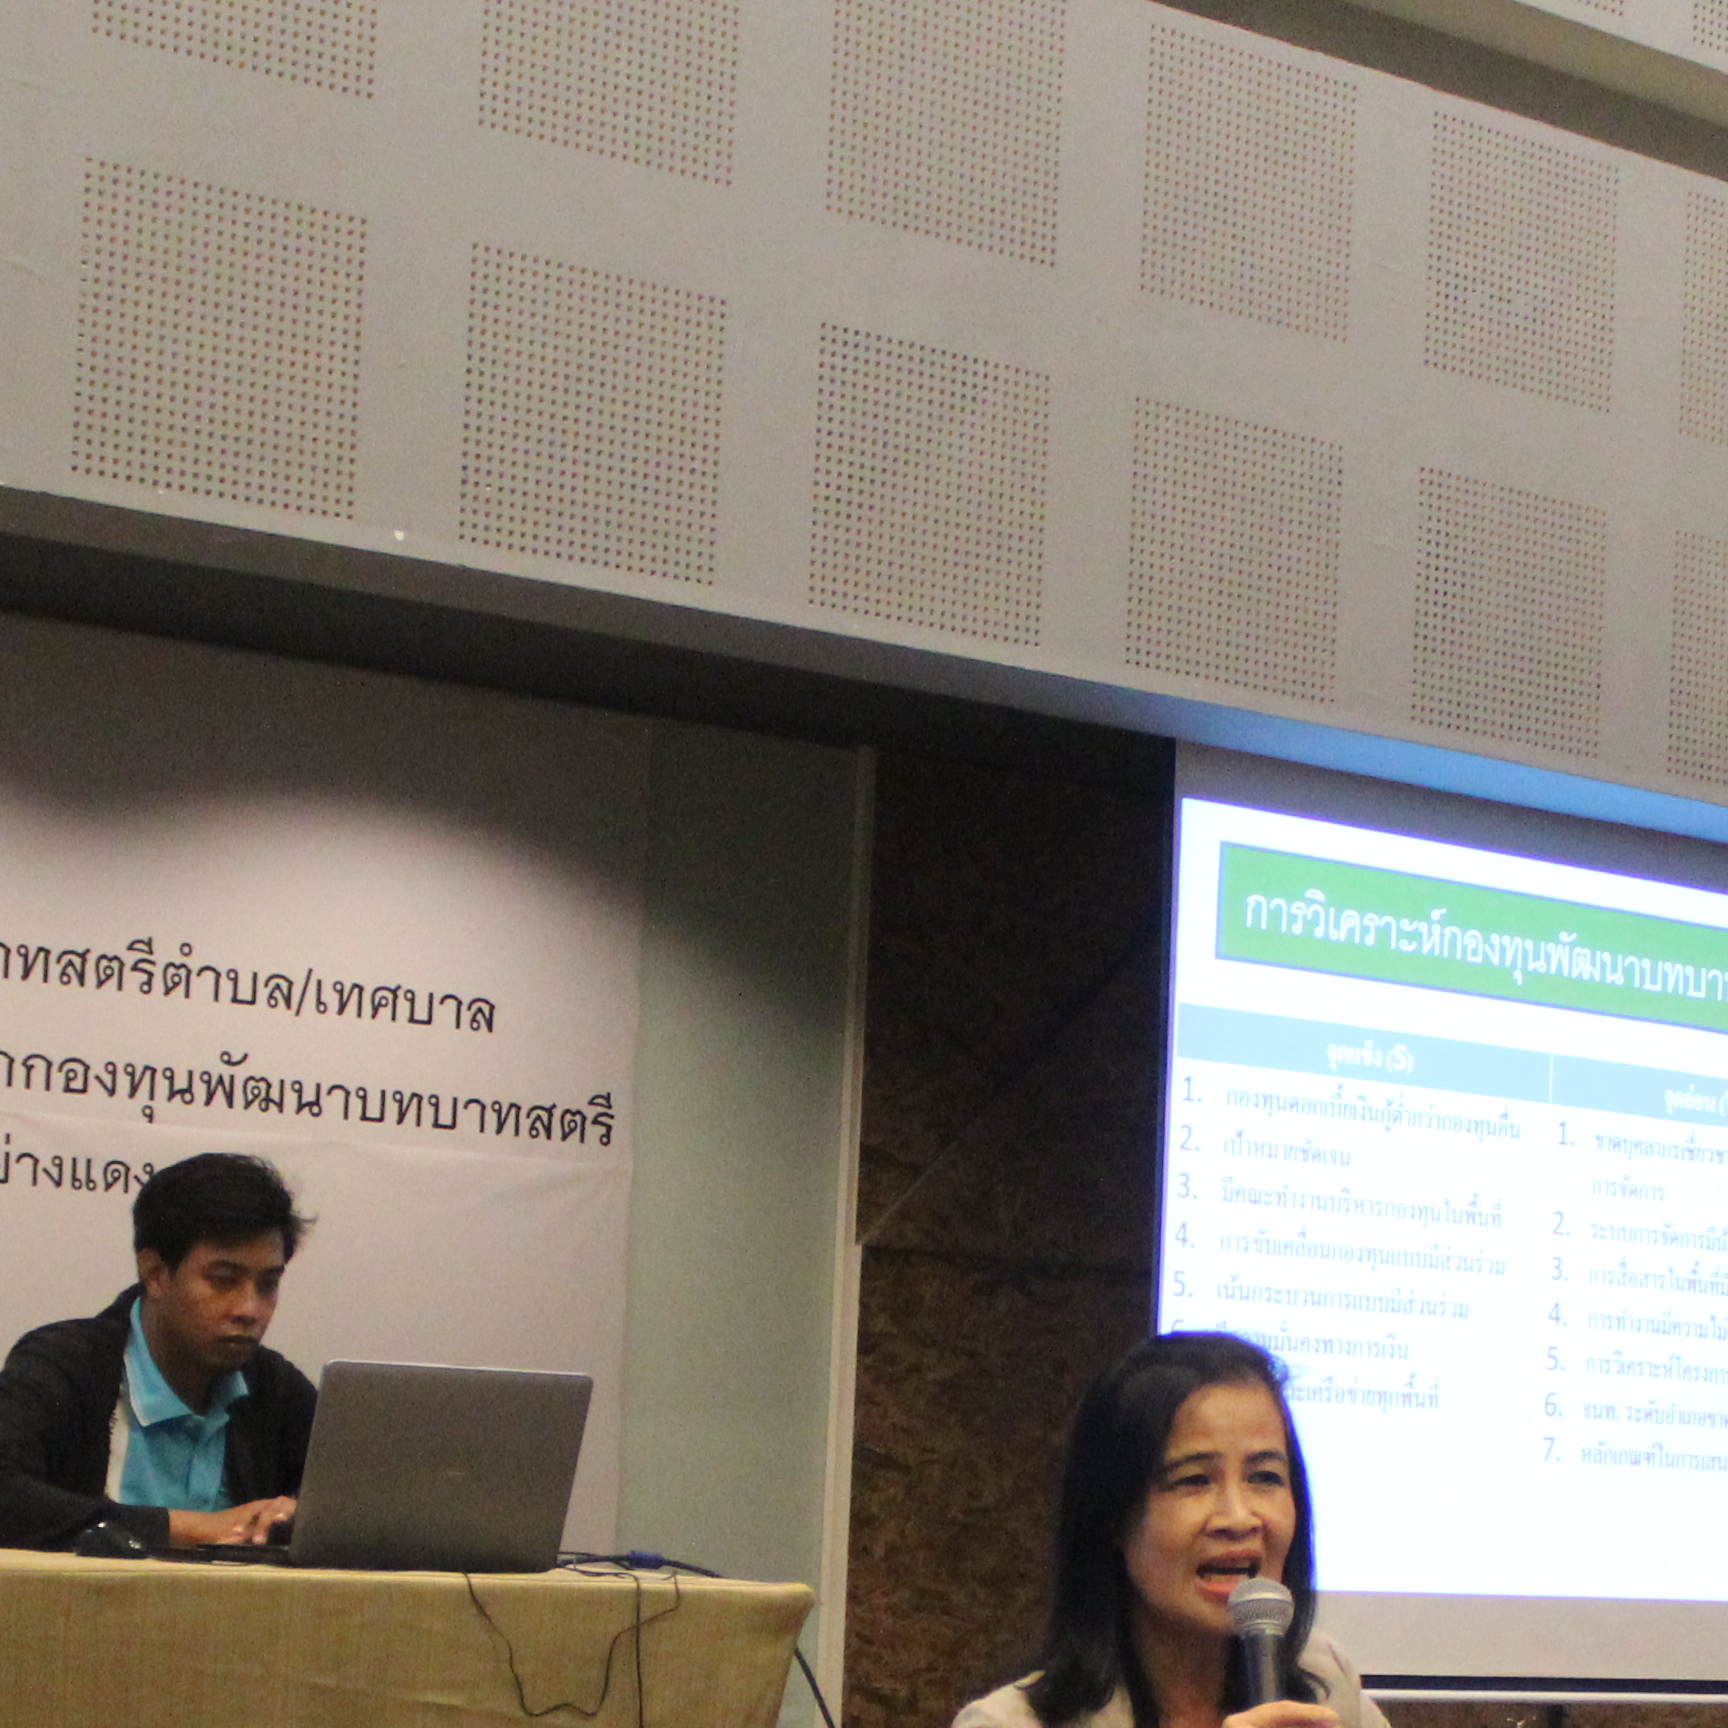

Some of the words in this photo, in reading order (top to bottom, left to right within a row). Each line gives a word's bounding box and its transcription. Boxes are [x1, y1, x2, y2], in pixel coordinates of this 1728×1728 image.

[1386, 1044, 1414, 1075] (S)
[1181, 1075, 1203, 1103] 1.
[1179, 1124, 1200, 1151] 2.
[1558, 1121, 1575, 1147] 1.
[1177, 1172, 1198, 1200] 3.
[1174, 1221, 1196, 1249] 4.
[1553, 1210, 1571, 1236] 2.
[1550, 1256, 1569, 1281] 3.
[1172, 1270, 1194, 1299] 5.
[1548, 1302, 1567, 1327] 4.
[1546, 1346, 1566, 1371] 5.
[1544, 1392, 1563, 1418] 6.
[1542, 1436, 1561, 1462] 7.
